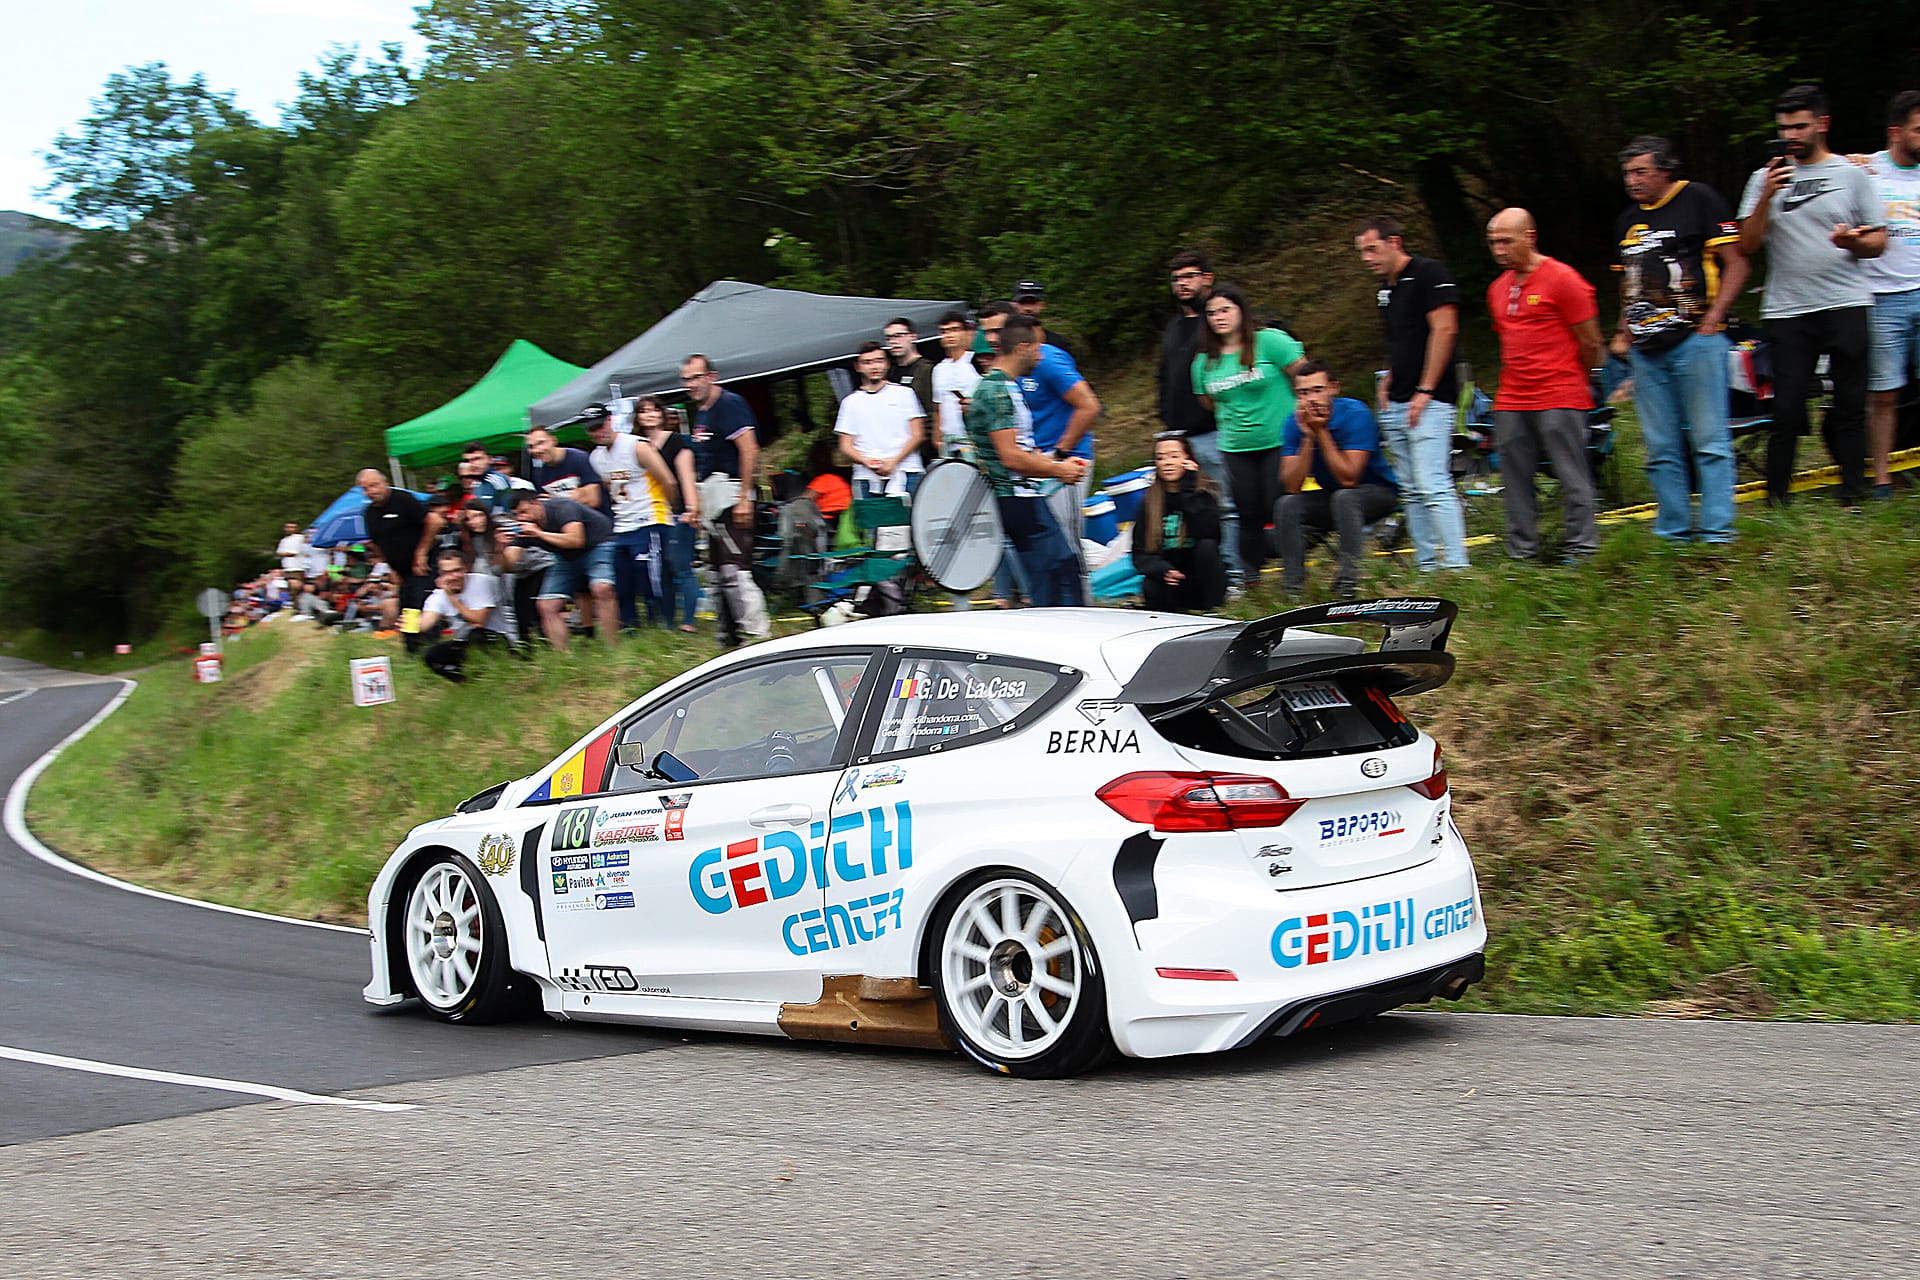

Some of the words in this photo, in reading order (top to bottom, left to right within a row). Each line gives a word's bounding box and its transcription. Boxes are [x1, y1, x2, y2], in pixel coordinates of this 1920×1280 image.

[917, 679, 934, 700] G.
[937, 679, 959, 699] De
[964, 679, 985, 699] La
[986, 677, 1027, 699] Casa
[1046, 729, 1141, 754] BERNA
[610, 811, 633, 819] JUAN
[633, 808, 663, 816] MOTOR
[561, 807, 590, 849] 18
[595, 824, 658, 841] KARTING
[483, 842, 511, 871] 40
[568, 875, 594, 889] Pavitek
[781, 887, 904, 956] CENTER
[1424, 897, 1473, 940] CENTE
[584, 964, 639, 991] TED
